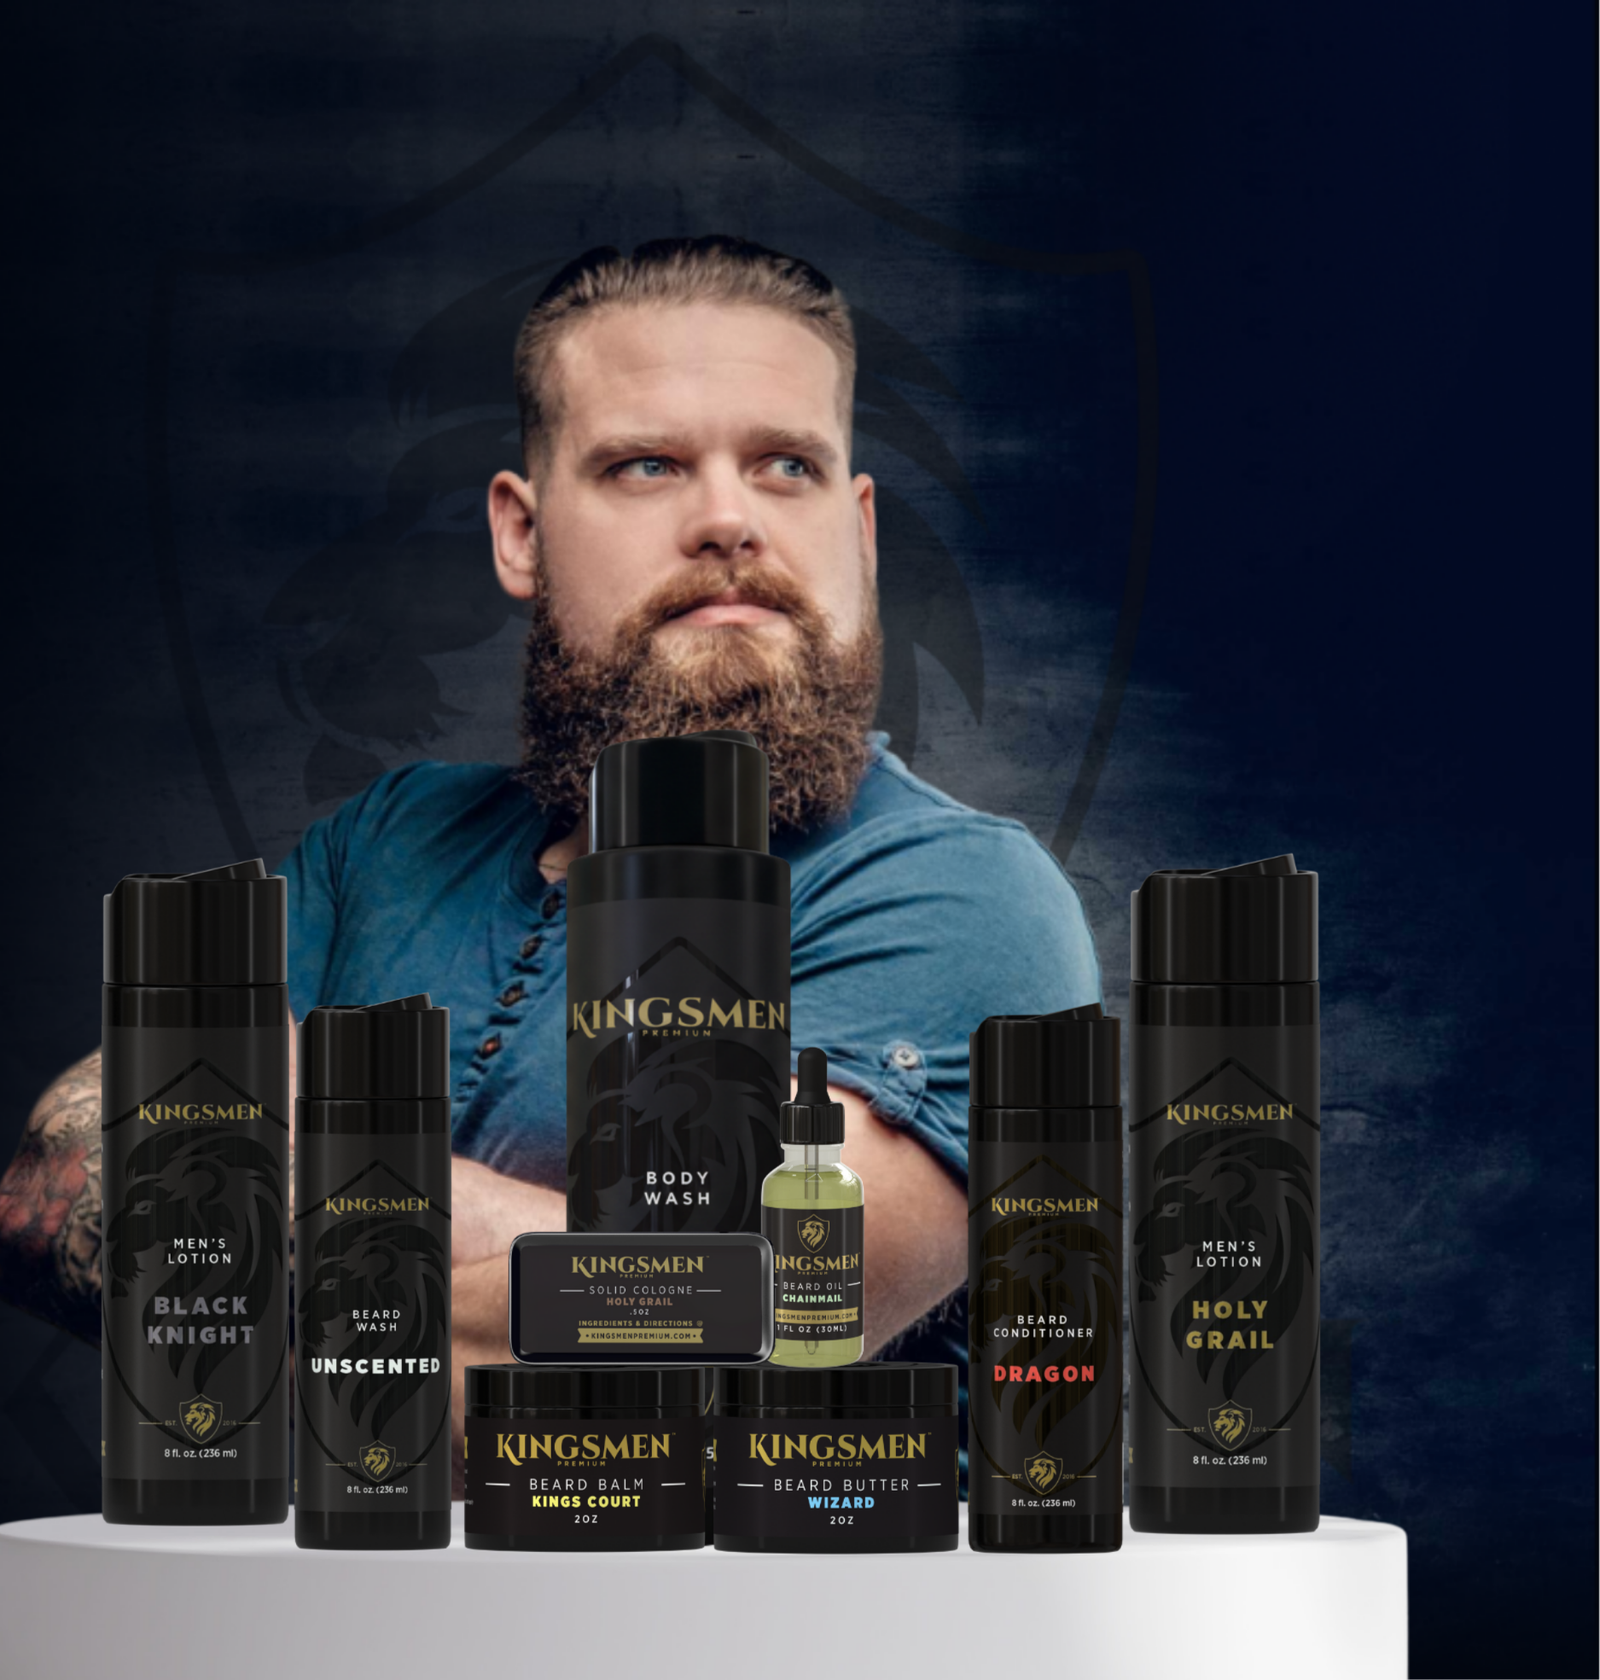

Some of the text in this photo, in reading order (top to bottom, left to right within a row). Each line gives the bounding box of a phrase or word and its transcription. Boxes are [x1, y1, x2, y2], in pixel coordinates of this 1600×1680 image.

[573, 996, 785, 1039] KINGSMEN
[138, 1103, 263, 1125] KINGSMEN
[1166, 1104, 1293, 1125] KINGSMEN
[646, 1171, 709, 1185] BODY
[644, 1191, 711, 1206] WASH
[325, 1197, 430, 1215] KINGSMEN
[991, 1197, 1099, 1216] KINGSMEN
[173, 1238, 226, 1250] MEN'S
[1202, 1241, 1256, 1252] MEN'S
[167, 1253, 232, 1264] LOTION
[775, 1253, 859, 1273] INGSMEN
[1196, 1256, 1262, 1268] LOTION
[571, 1256, 704, 1278] KINGSMEN
[589, 1286, 693, 1295] SOLID COLOGNE
[783, 1281, 843, 1291] BEARD OIL
[606, 1298, 673, 1306] HOLY GRAIL
[782, 1294, 843, 1303] CHAINMAIL
[154, 1297, 248, 1315] BLACK
[1192, 1301, 1268, 1319] HOLY
[352, 1310, 401, 1319] BEARD
[775, 1312, 853, 1321] INGSMENPREMIUM.COM
[1017, 1315, 1068, 1325] BEARD
[356, 1323, 398, 1332] WASH
[783, 1324, 794, 1333] FL
[798, 1325, 812, 1333] OZ
[816, 1324, 848, 1334] (30ML)
[993, 1328, 1093, 1338] CONDITIONER
[148, 1326, 254, 1344] KNIGHT
[591, 1332, 691, 1340] KINGSMENPREMIUM.COM
[1186, 1330, 1274, 1349] GRAIL
[311, 1358, 440, 1374] UNSCENTED
[994, 1365, 1095, 1382] DRAGON
[164, 1448, 238, 1459] 8 fl. oz. (236 ml)
[496, 1433, 670, 1466] KINGSMEN
[749, 1433, 926, 1467] KINGSMEN
[1192, 1456, 1199, 1465] 8
[1201, 1456, 1210, 1465] fl.
[1228, 1456, 1250, 1466] (236
[1252, 1456, 1268, 1466] ml)
[346, 1485, 353, 1494] 8
[353, 1485, 361, 1494] fl.
[375, 1485, 394, 1495] (236
[395, 1486, 409, 1495] ml)
[530, 1479, 644, 1491] BEARD BALM
[774, 1479, 909, 1492] BEARD BUTTER
[532, 1496, 641, 1508] KINGS COURT
[808, 1497, 875, 1509] WIZARD
[1011, 1499, 1017, 1507] 8
[1018, 1499, 1027, 1507] fl.
[1041, 1499, 1061, 1508] (236
[1062, 1499, 1076, 1508] ml)
